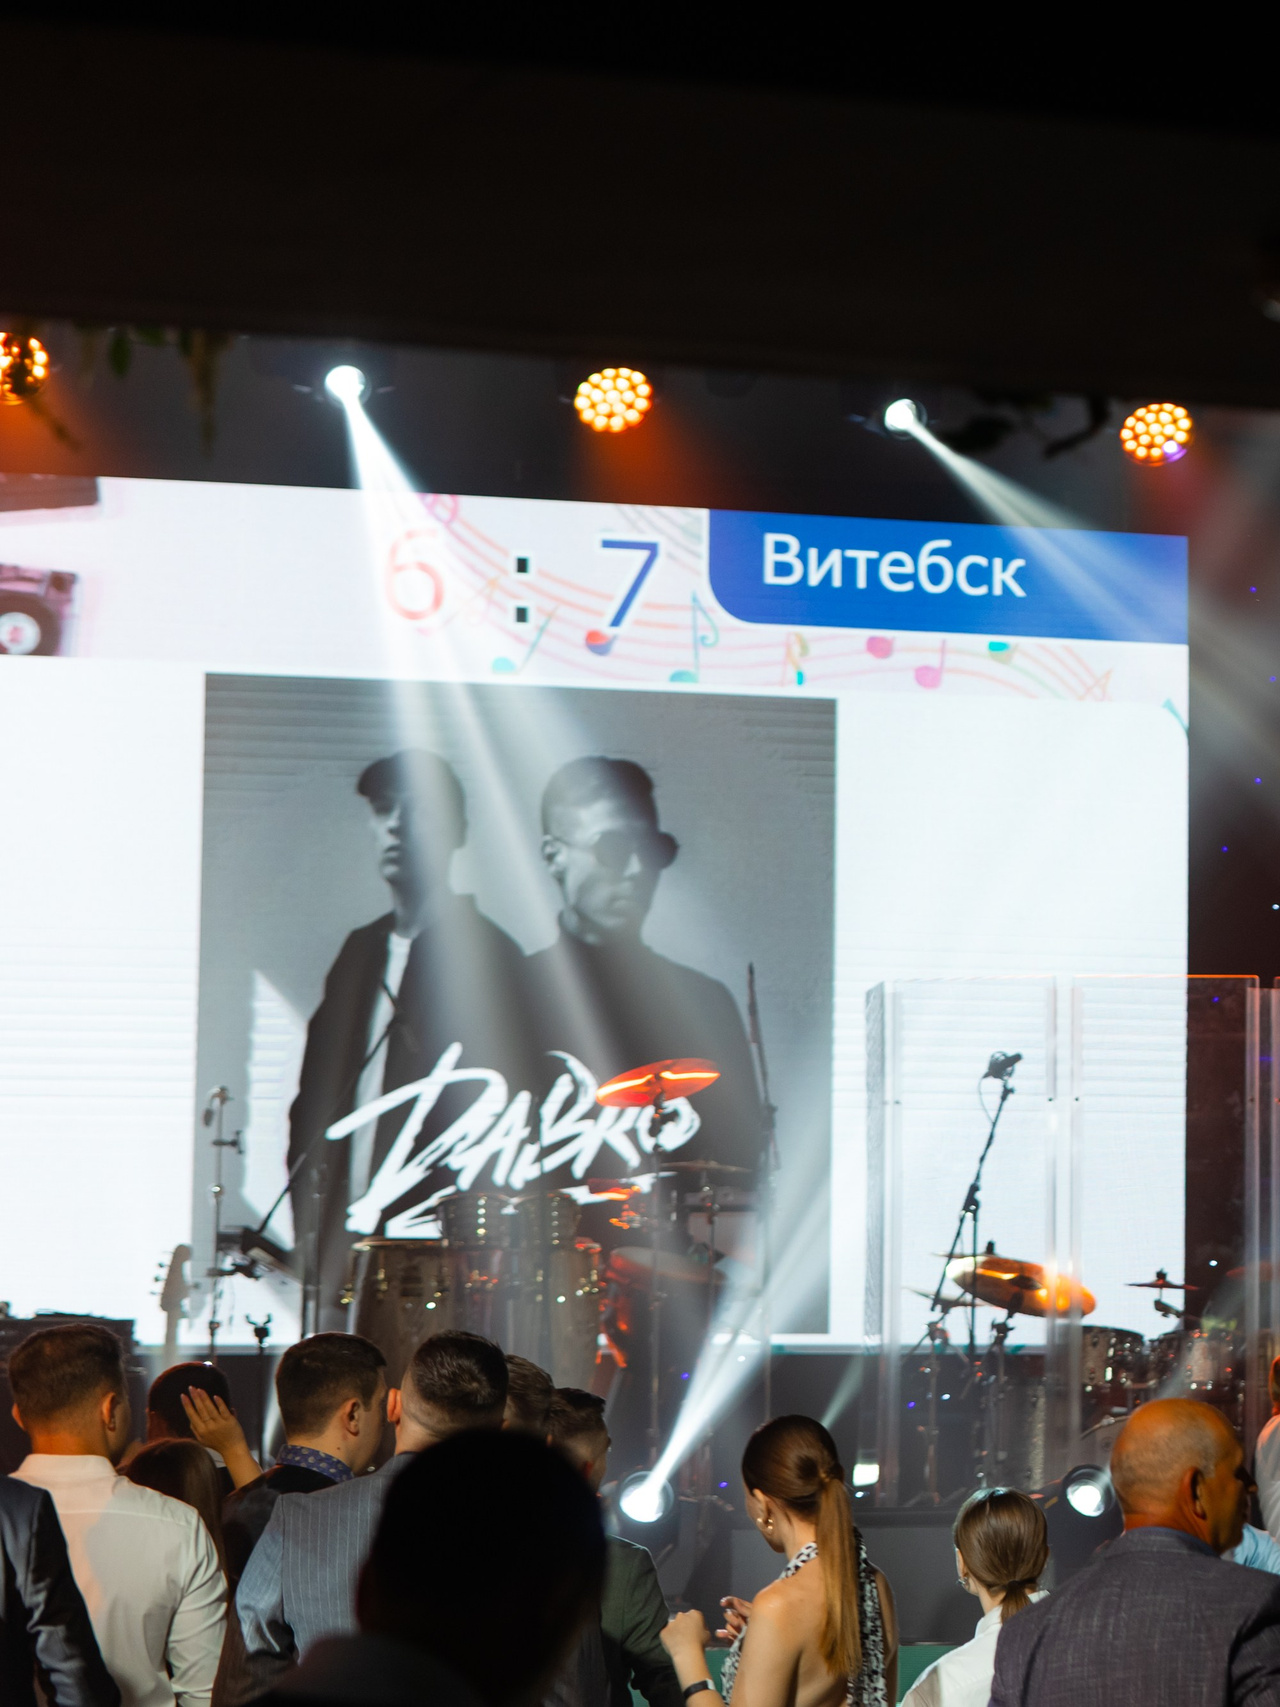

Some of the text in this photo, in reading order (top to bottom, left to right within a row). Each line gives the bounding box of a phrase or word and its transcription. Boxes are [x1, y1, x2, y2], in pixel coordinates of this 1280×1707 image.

[386, 530, 444, 621] 6
[600, 539, 658, 628] 7
[763, 532, 1026, 597] Витебск
